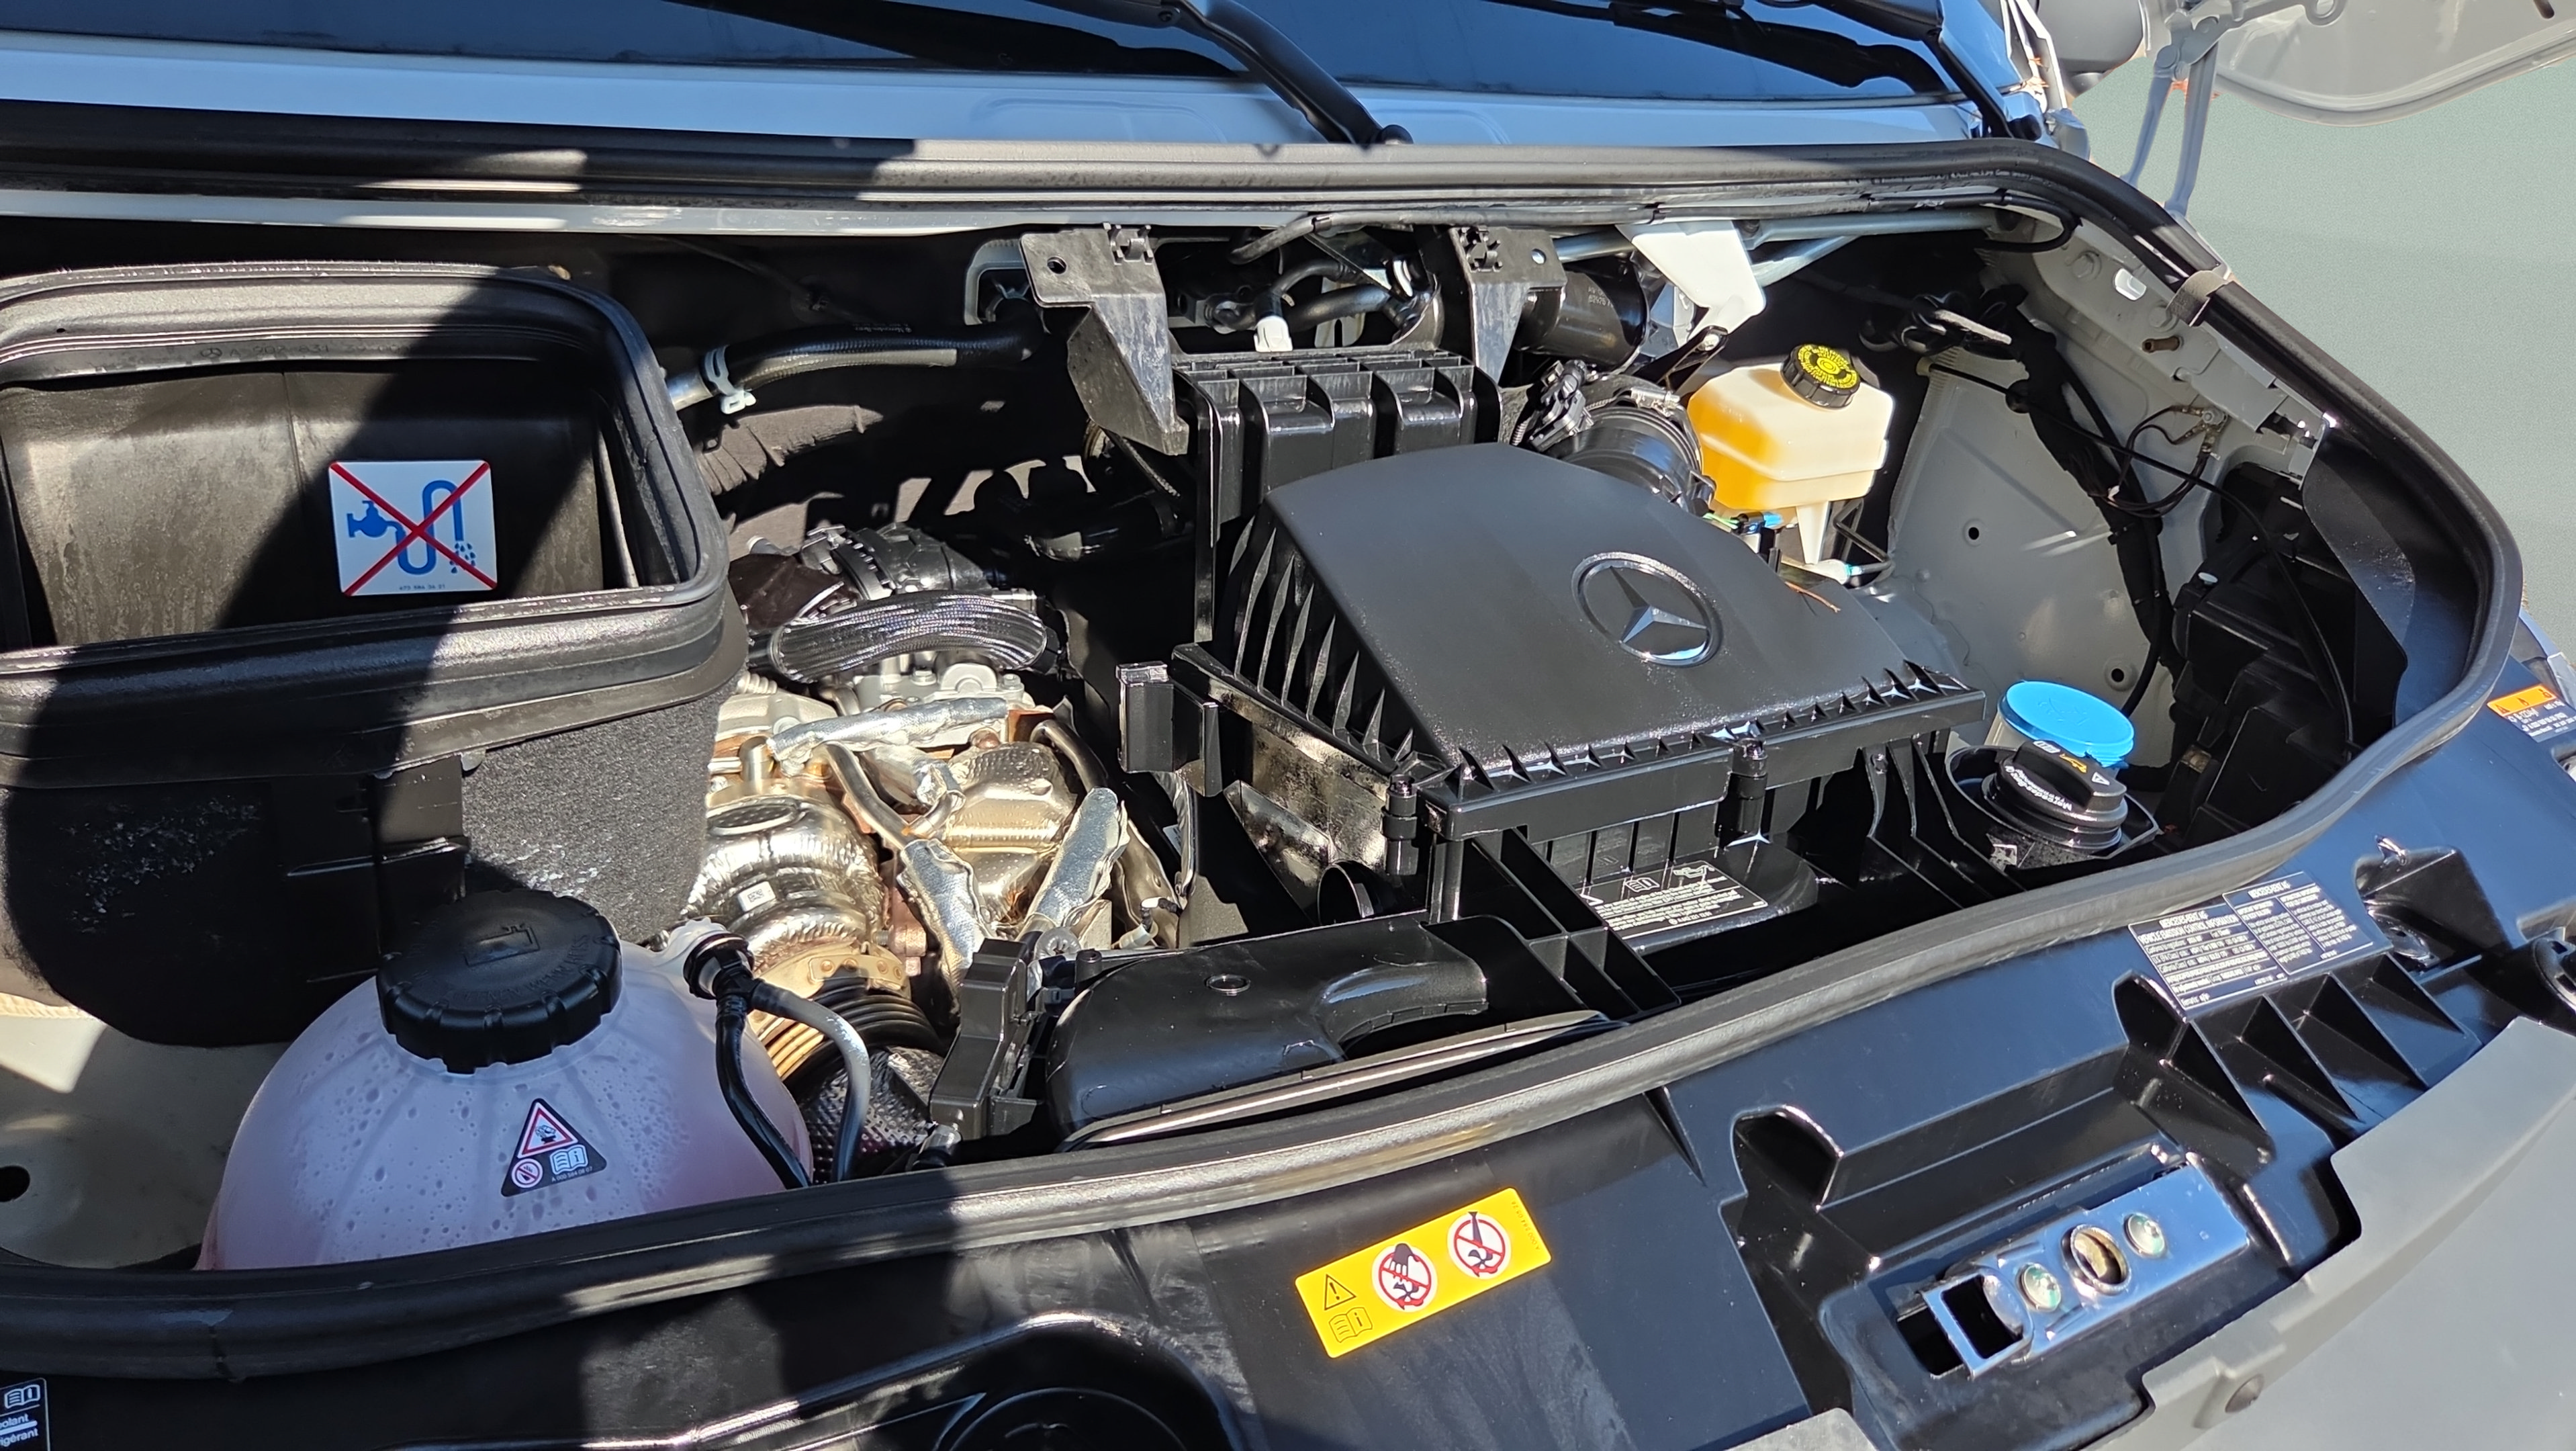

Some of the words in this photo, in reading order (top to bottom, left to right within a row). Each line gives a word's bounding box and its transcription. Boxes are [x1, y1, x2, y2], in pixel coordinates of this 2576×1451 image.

[2137, 931, 2162, 944] VEHICLE
[2160, 927, 2185, 939] EMISSION
[2184, 922, 2208, 933] CONTROL
[2205, 915, 2238, 928] INFORMATION
